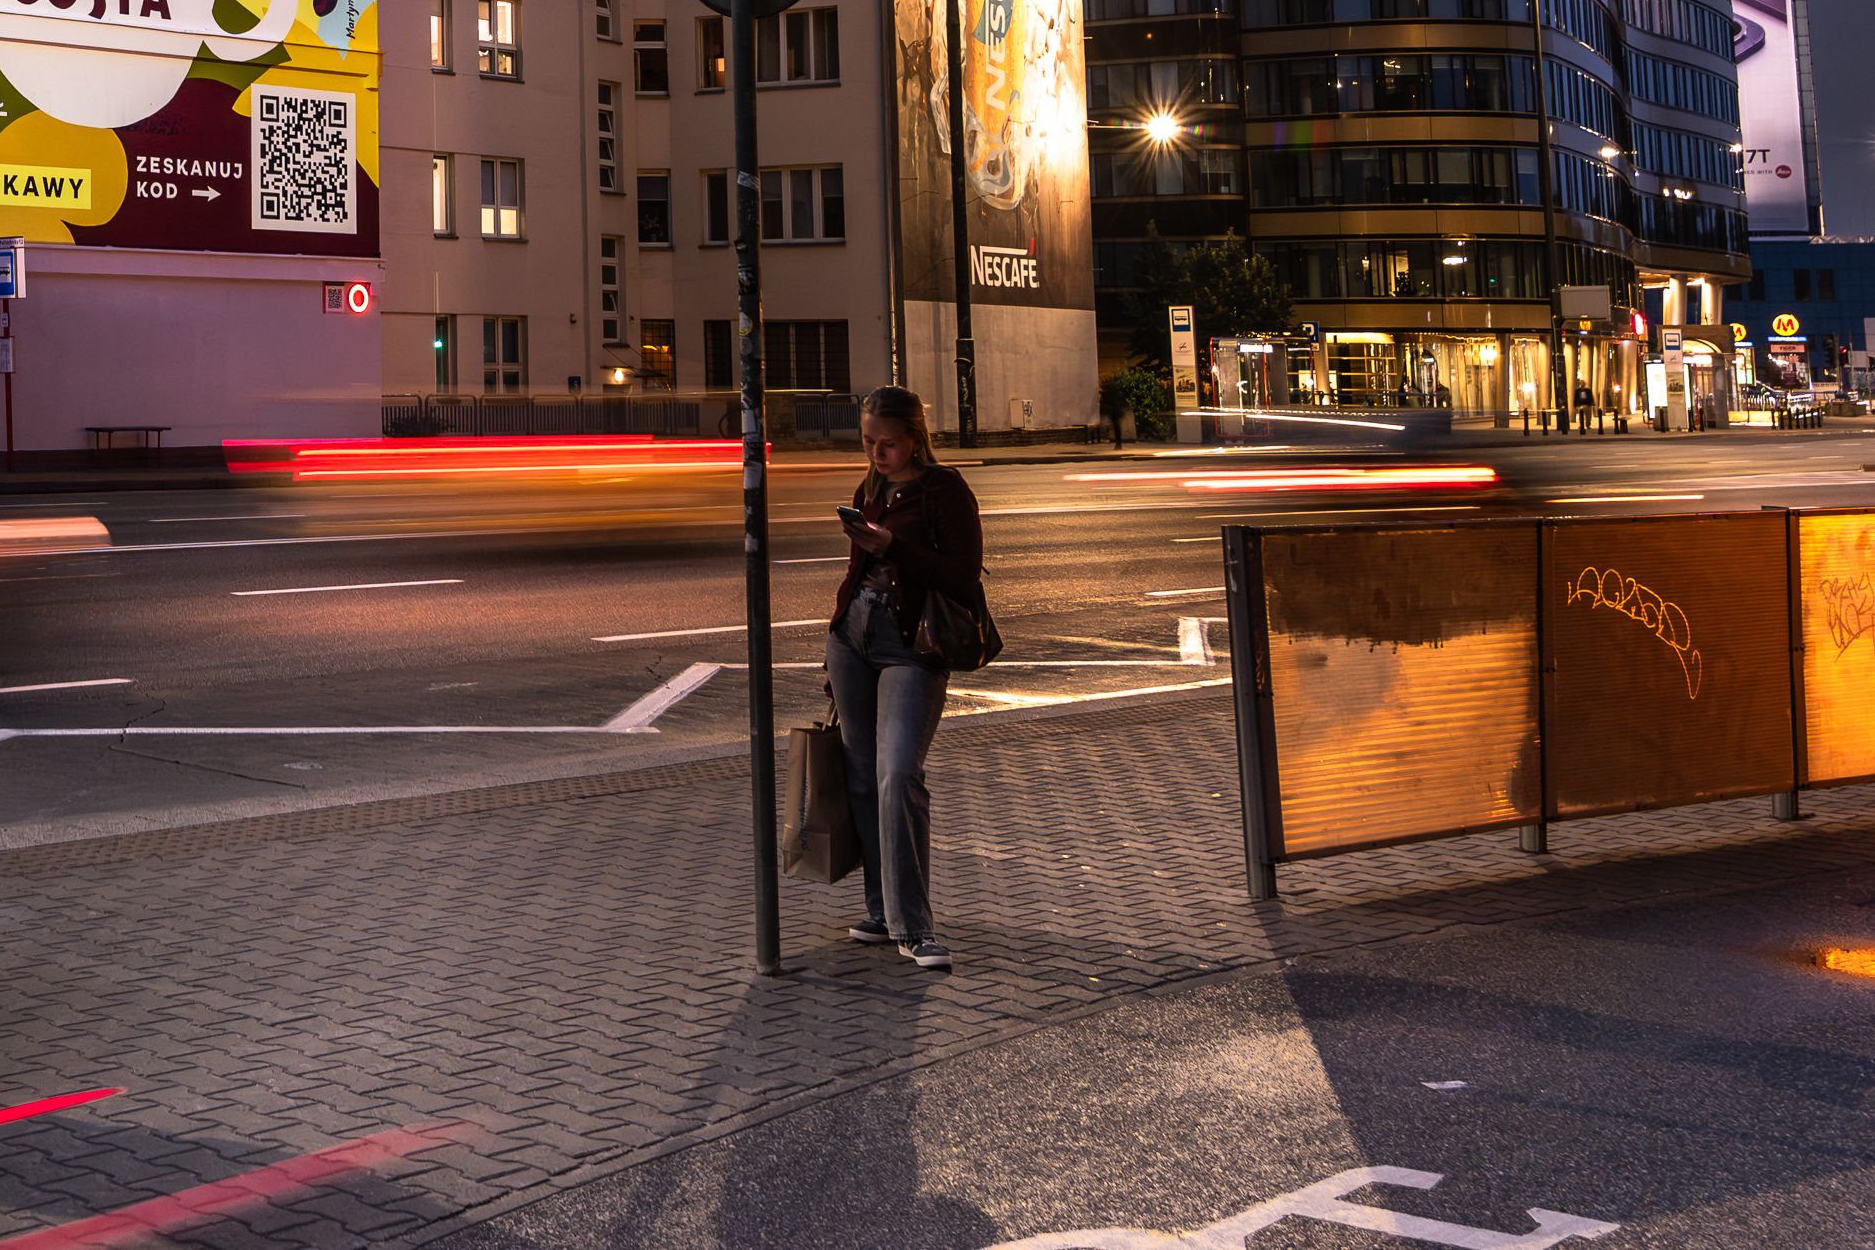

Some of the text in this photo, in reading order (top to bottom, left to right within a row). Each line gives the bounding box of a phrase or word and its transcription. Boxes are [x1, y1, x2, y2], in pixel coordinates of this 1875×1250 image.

[136, 155, 244, 179] ZESKANUJ
[1746, 149, 1771, 163] 7T
[2, 173, 84, 200] KAWY
[136, 181, 179, 201] KOD
[970, 237, 1039, 289] NESCAFÉ
